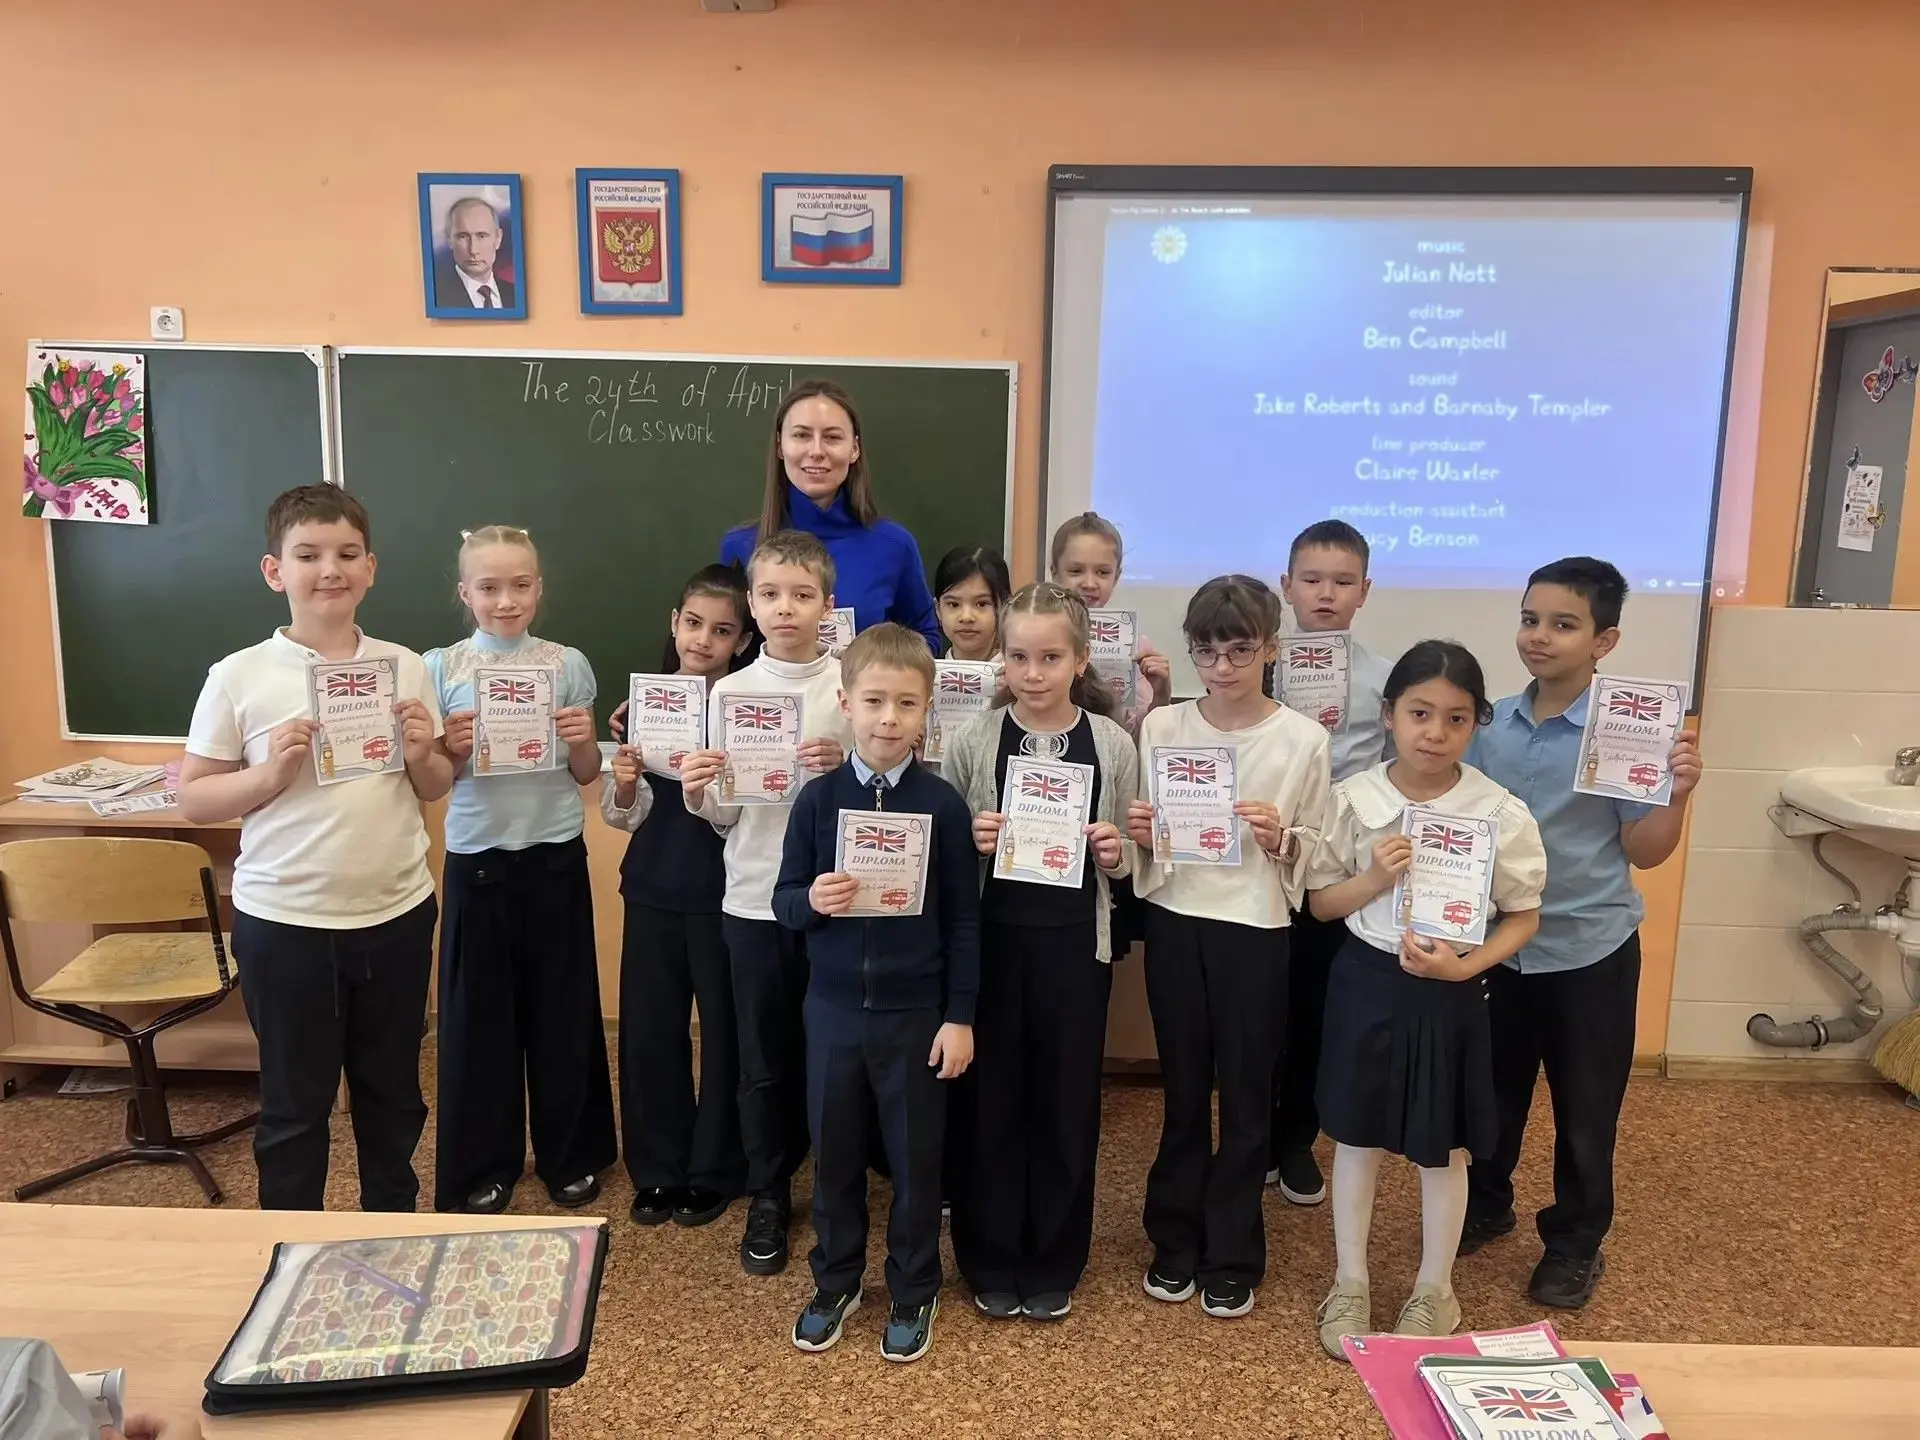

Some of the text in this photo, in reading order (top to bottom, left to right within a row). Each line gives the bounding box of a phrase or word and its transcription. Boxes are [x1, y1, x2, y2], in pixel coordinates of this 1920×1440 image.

[1416, 240, 1467, 253] music
[1382, 259, 1498, 283] Julian Nott
[1407, 303, 1465, 320] editor
[1363, 325, 1507, 357] Ben Campbell
[1409, 371, 1458, 387] sound
[520, 361, 793, 417] The 24th of April
[1252, 392, 1612, 422] Jake Roberts and Barnaby Templer
[588, 407, 717, 445] Classwork
[1371, 435, 1486, 455] line producer
[1355, 457, 1419, 481] Claire
[1330, 501, 1424, 520] production
[1366, 525, 1479, 551] ucy Benson
[1289, 673, 1335, 684] DIPLOMA
[328, 699, 380, 715] DIPLOMA
[488, 707, 537, 716] DIPLOMA
[643, 715, 688, 725] DIPLOMA
[1604, 721, 1661, 736] DIPLOMA
[733, 734, 784, 744] DIPLOMA
[1166, 788, 1219, 798] DIPLOMA
[1017, 802, 1068, 817] DIPLOMA
[852, 855, 906, 866] DIPLOMA
[1416, 853, 1472, 871] DIPLOMA
[1497, 1428, 1598, 1440] DIPLOMA
